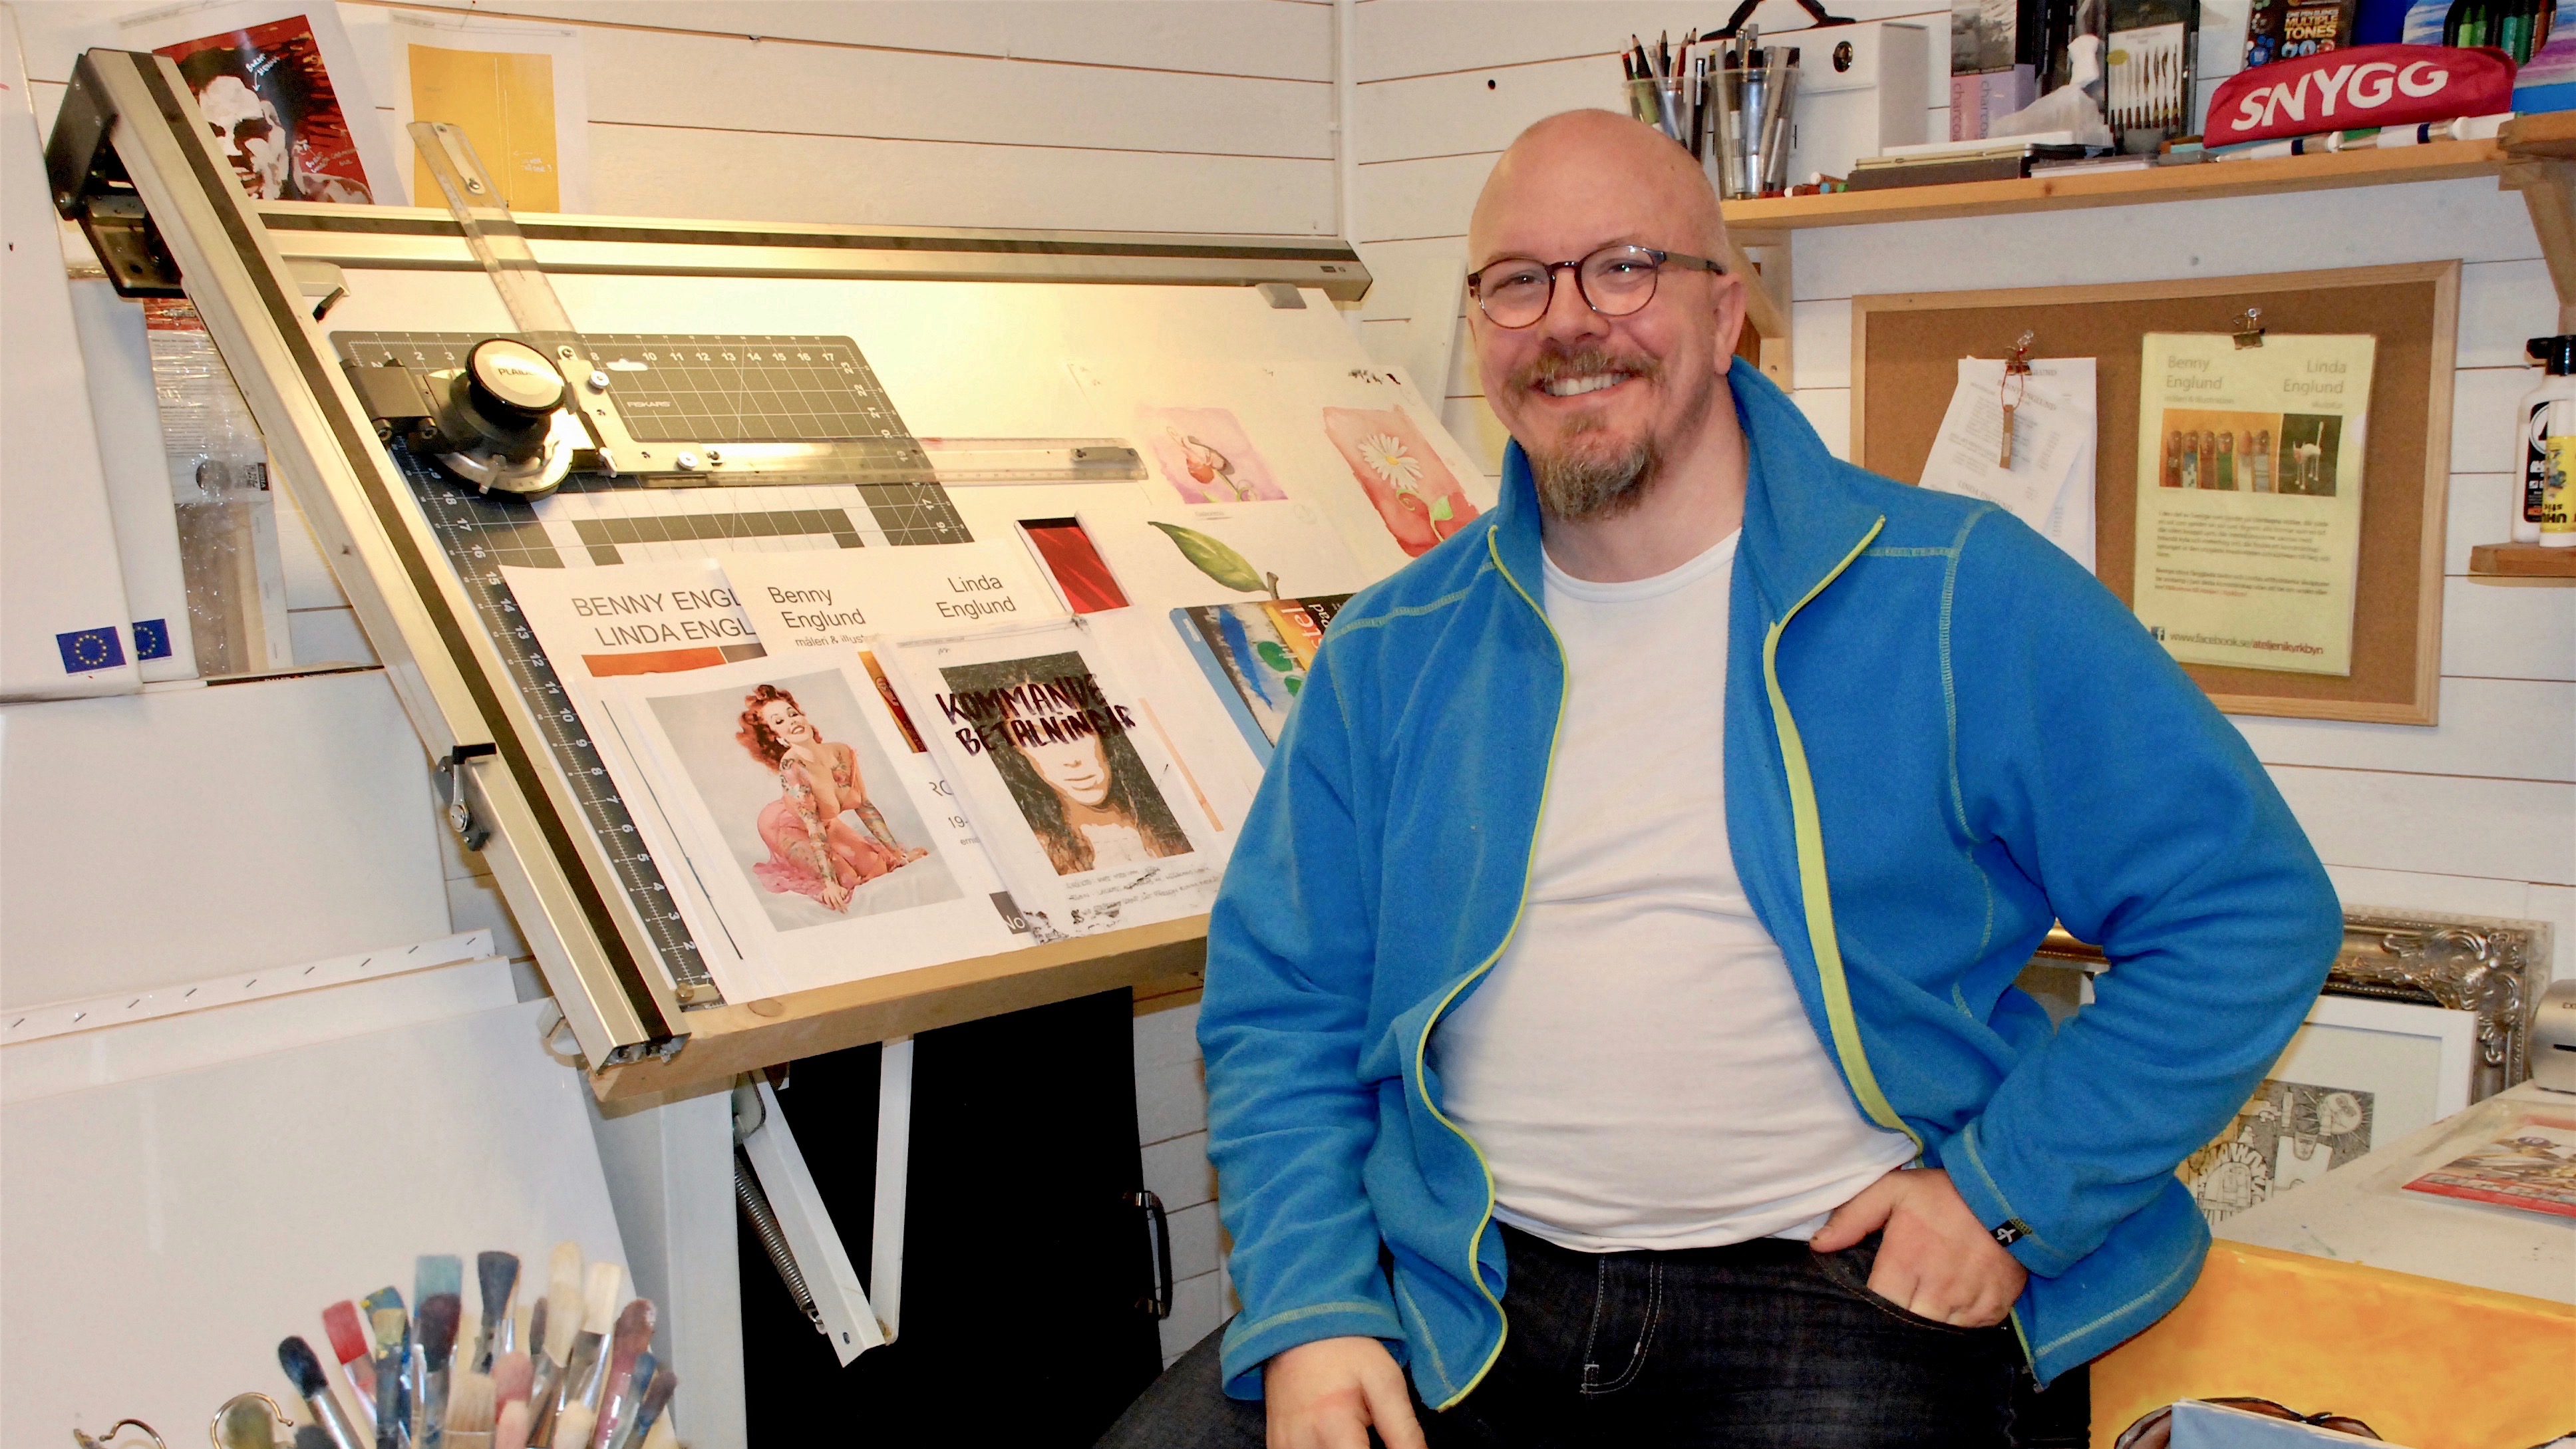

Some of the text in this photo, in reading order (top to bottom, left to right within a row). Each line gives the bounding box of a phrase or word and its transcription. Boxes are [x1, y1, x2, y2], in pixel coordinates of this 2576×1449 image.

[2285, 15, 2338, 28] MULTIPLE
[2284, 25, 2337, 40] TONES
[2230, 60, 2450, 132] SNYGG
[414, 352, 425, 361] 2
[445, 352, 456, 361] 3
[590, 352, 600, 361] 8
[642, 352, 658, 361] 10
[670, 352, 685, 361] 11
[696, 352, 711, 361] 12
[721, 352, 736, 361] 13
[747, 353, 762, 361] 14
[772, 353, 787, 361] 15
[797, 353, 812, 361] 16
[822, 353, 834, 361] 17
[2168, 355, 2210, 372] Benny
[2307, 360, 2347, 373] Linda
[2166, 375, 2223, 391] Englund
[2283, 379, 2344, 395] Englund
[947, 573, 1004, 593] Linda
[767, 586, 832, 606] Benny
[571, 593, 664, 617] BENNY
[936, 596, 1017, 619] Englund
[781, 608, 866, 631] Englund
[595, 617, 756, 646] LINDA ENGL
[935, 673, 1107, 725] KOMMANDE
